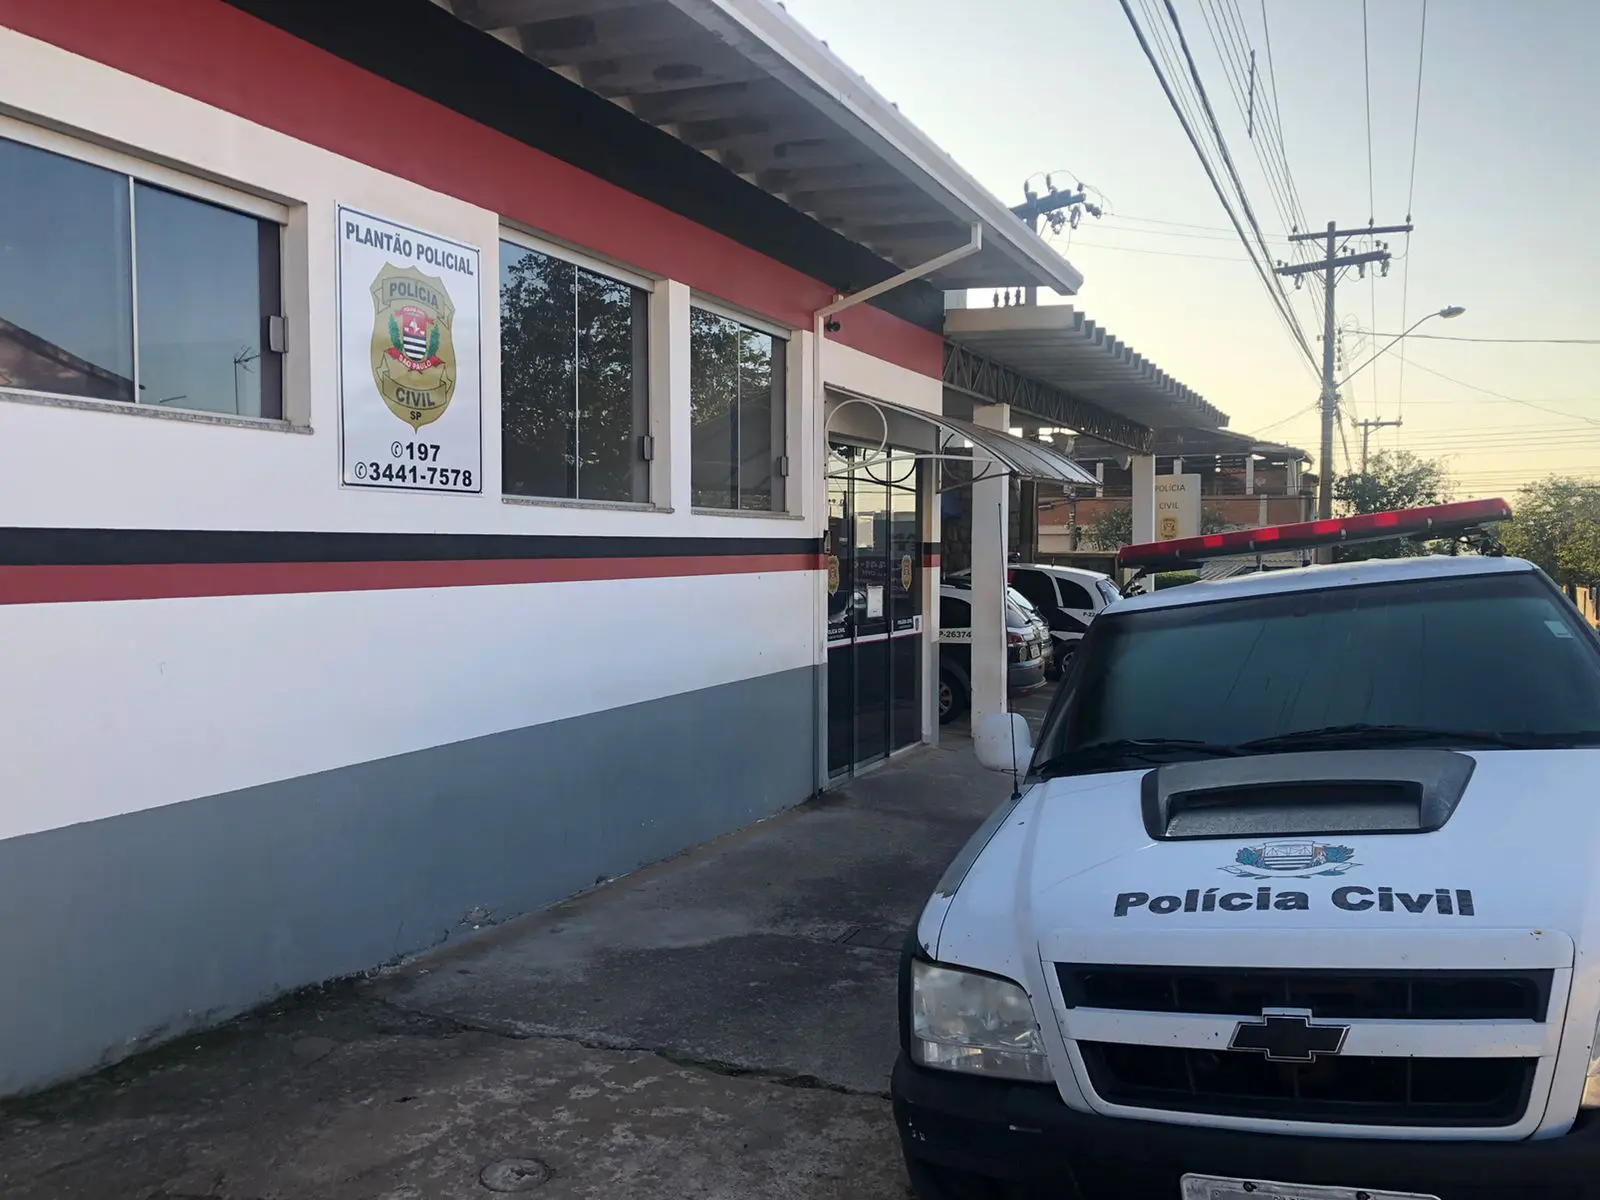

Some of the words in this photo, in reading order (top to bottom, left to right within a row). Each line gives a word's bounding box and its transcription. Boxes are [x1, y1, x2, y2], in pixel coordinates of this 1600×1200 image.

[346, 221, 412, 257] PLANTÃO
[416, 243, 474, 276] POLICIAL
[396, 387, 436, 407] CIVIL
[410, 410, 422, 421] SP
[406, 442, 441, 462] 197
[369, 462, 472, 487] 3441-7578
[1159, 502, 1180, 510] CIVIL
[1114, 887, 1310, 917] Polícia
[1331, 886, 1475, 916] Civil
